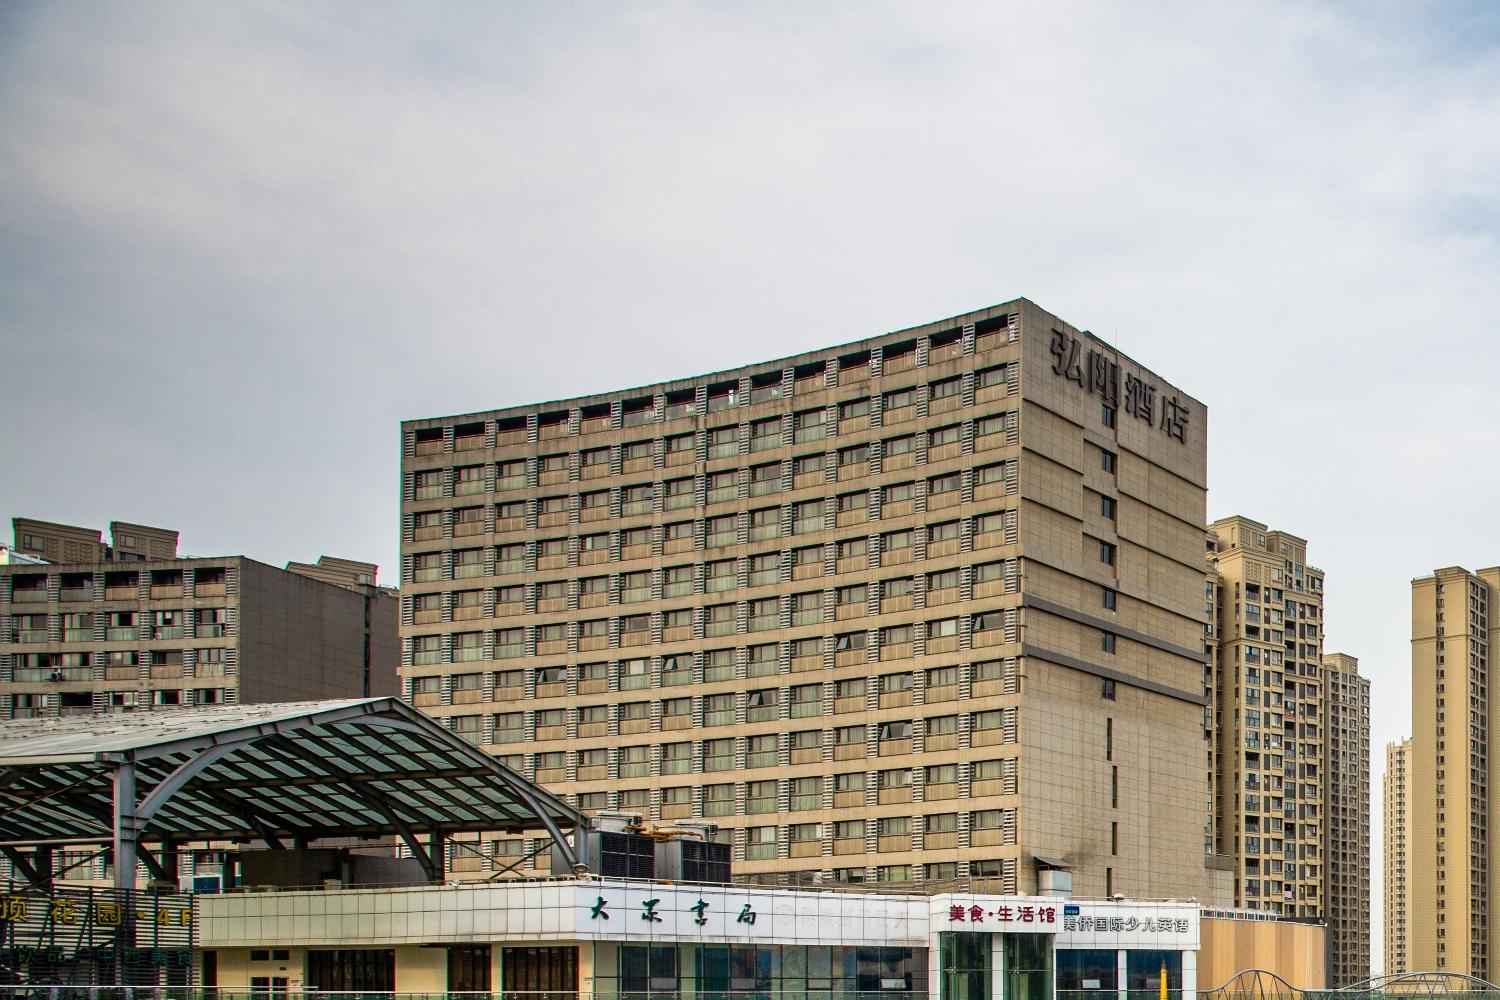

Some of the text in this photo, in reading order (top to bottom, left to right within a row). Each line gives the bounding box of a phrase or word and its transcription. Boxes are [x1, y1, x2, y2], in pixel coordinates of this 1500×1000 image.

[1050, 327, 1189, 444] 弘阳酒店
[1064, 915, 1189, 933] 美侨国际少儿英语
